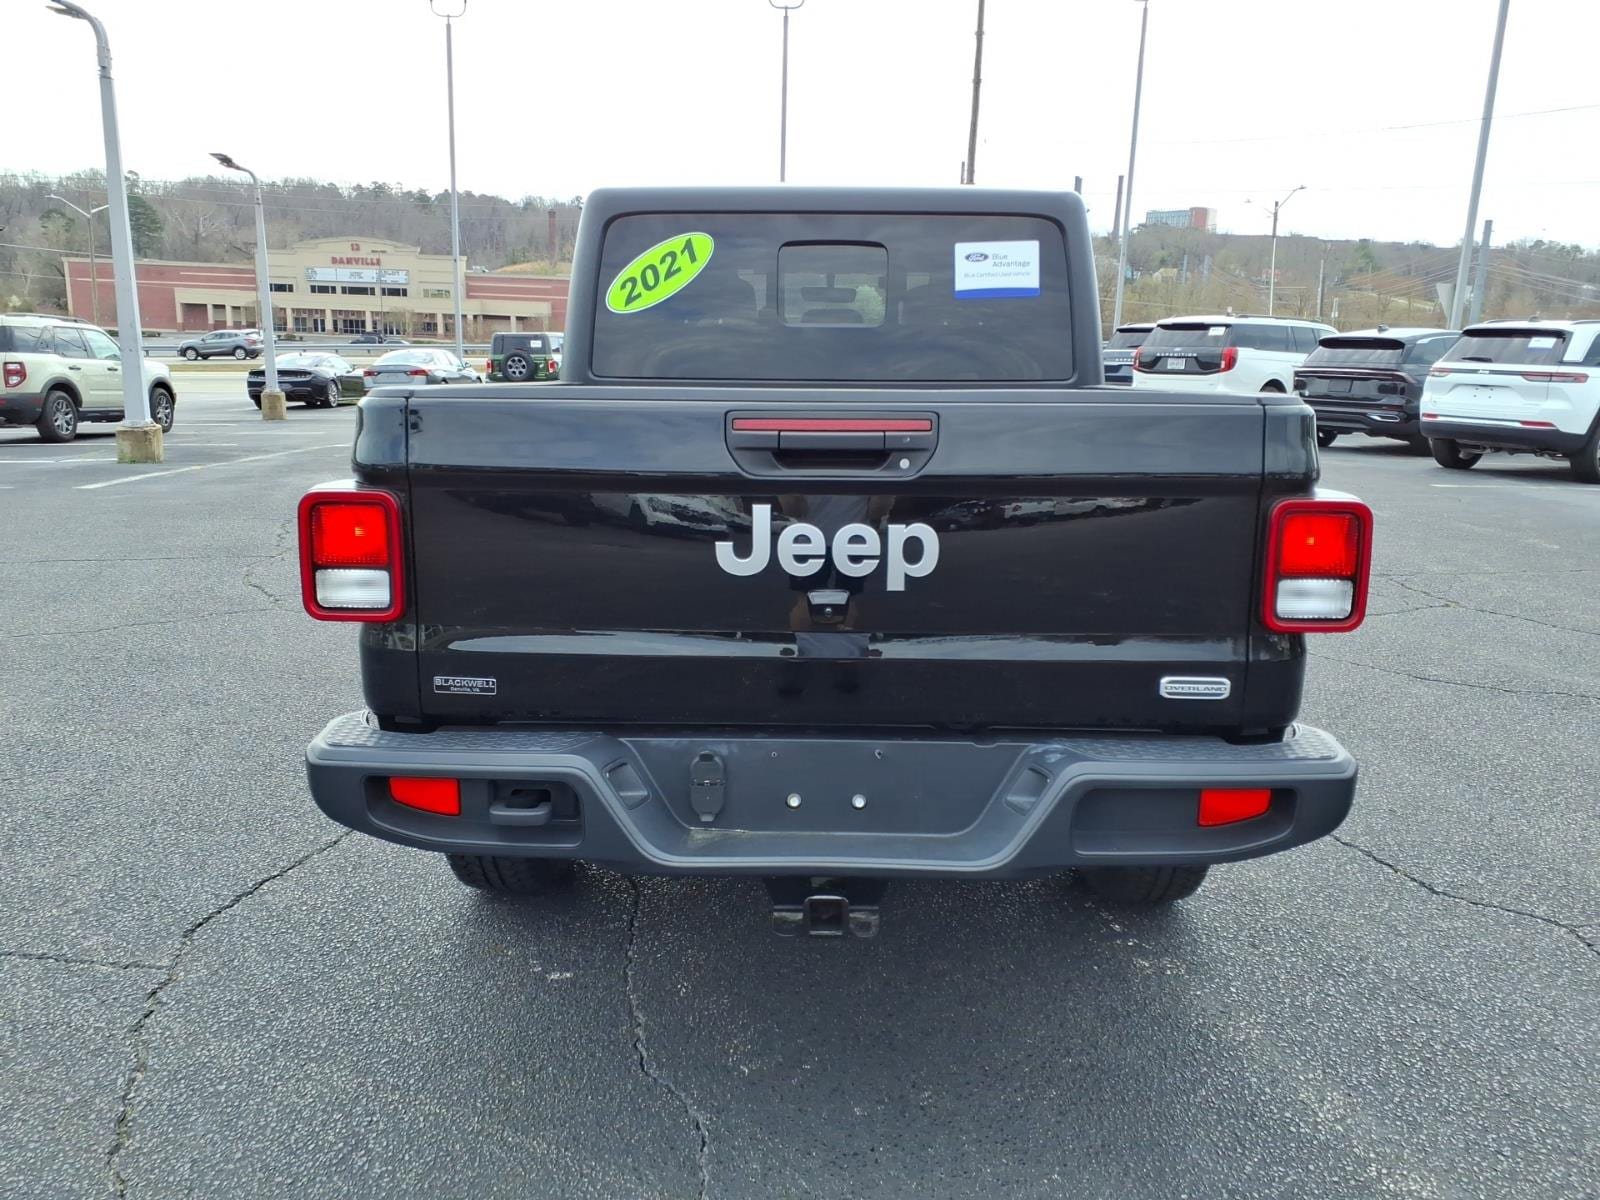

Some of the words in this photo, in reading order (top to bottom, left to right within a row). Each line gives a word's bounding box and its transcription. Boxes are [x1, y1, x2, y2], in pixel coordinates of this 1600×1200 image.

[331, 256, 382, 266] DANVILLE
[620, 237, 698, 307] 2021
[714, 503, 940, 592] Jeep
[434, 678, 495, 688] BLACKWELL
